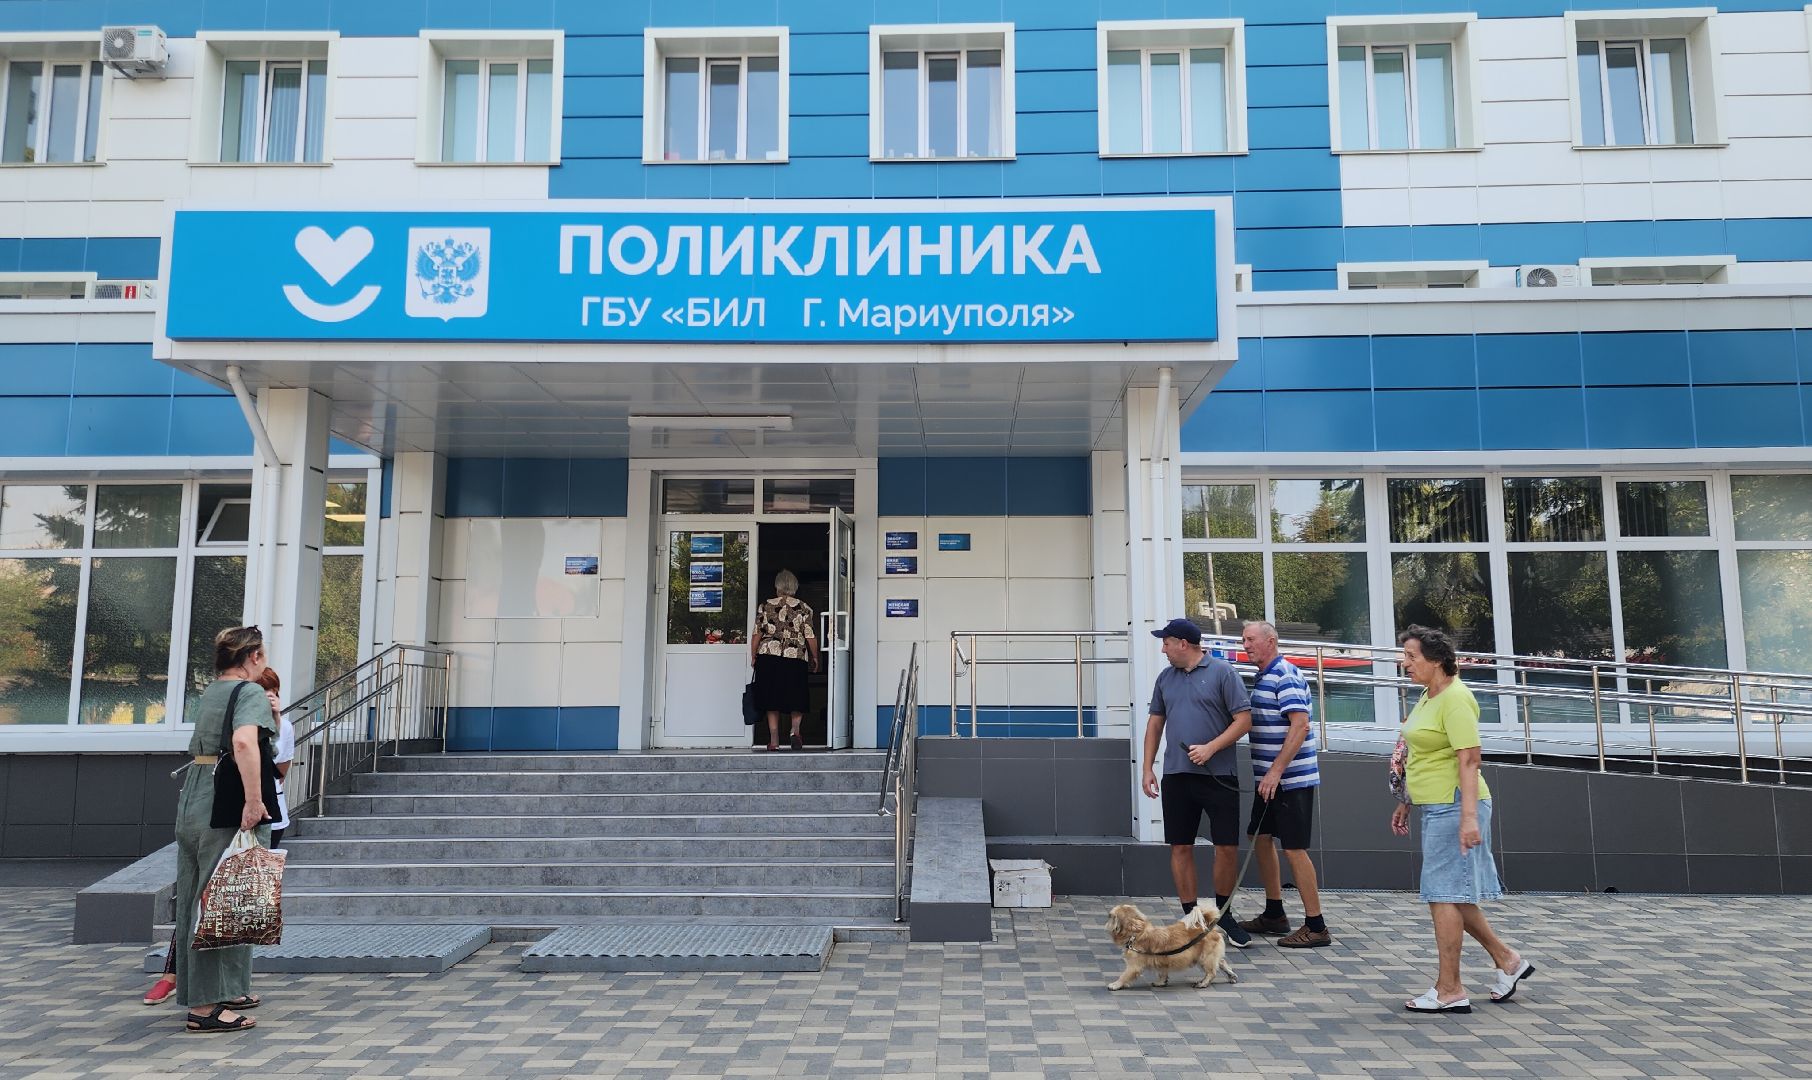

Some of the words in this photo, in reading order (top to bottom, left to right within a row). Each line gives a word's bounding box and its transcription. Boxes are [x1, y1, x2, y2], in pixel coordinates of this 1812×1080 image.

[559, 224, 1102, 276] ПОЛИКЛИНИКА
[582, 296, 652, 327] ГБУ
[661, 297, 766, 327] «БИЛ
[803, 298, 826, 327] Г.
[838, 298, 1075, 335] Мариуполя»
